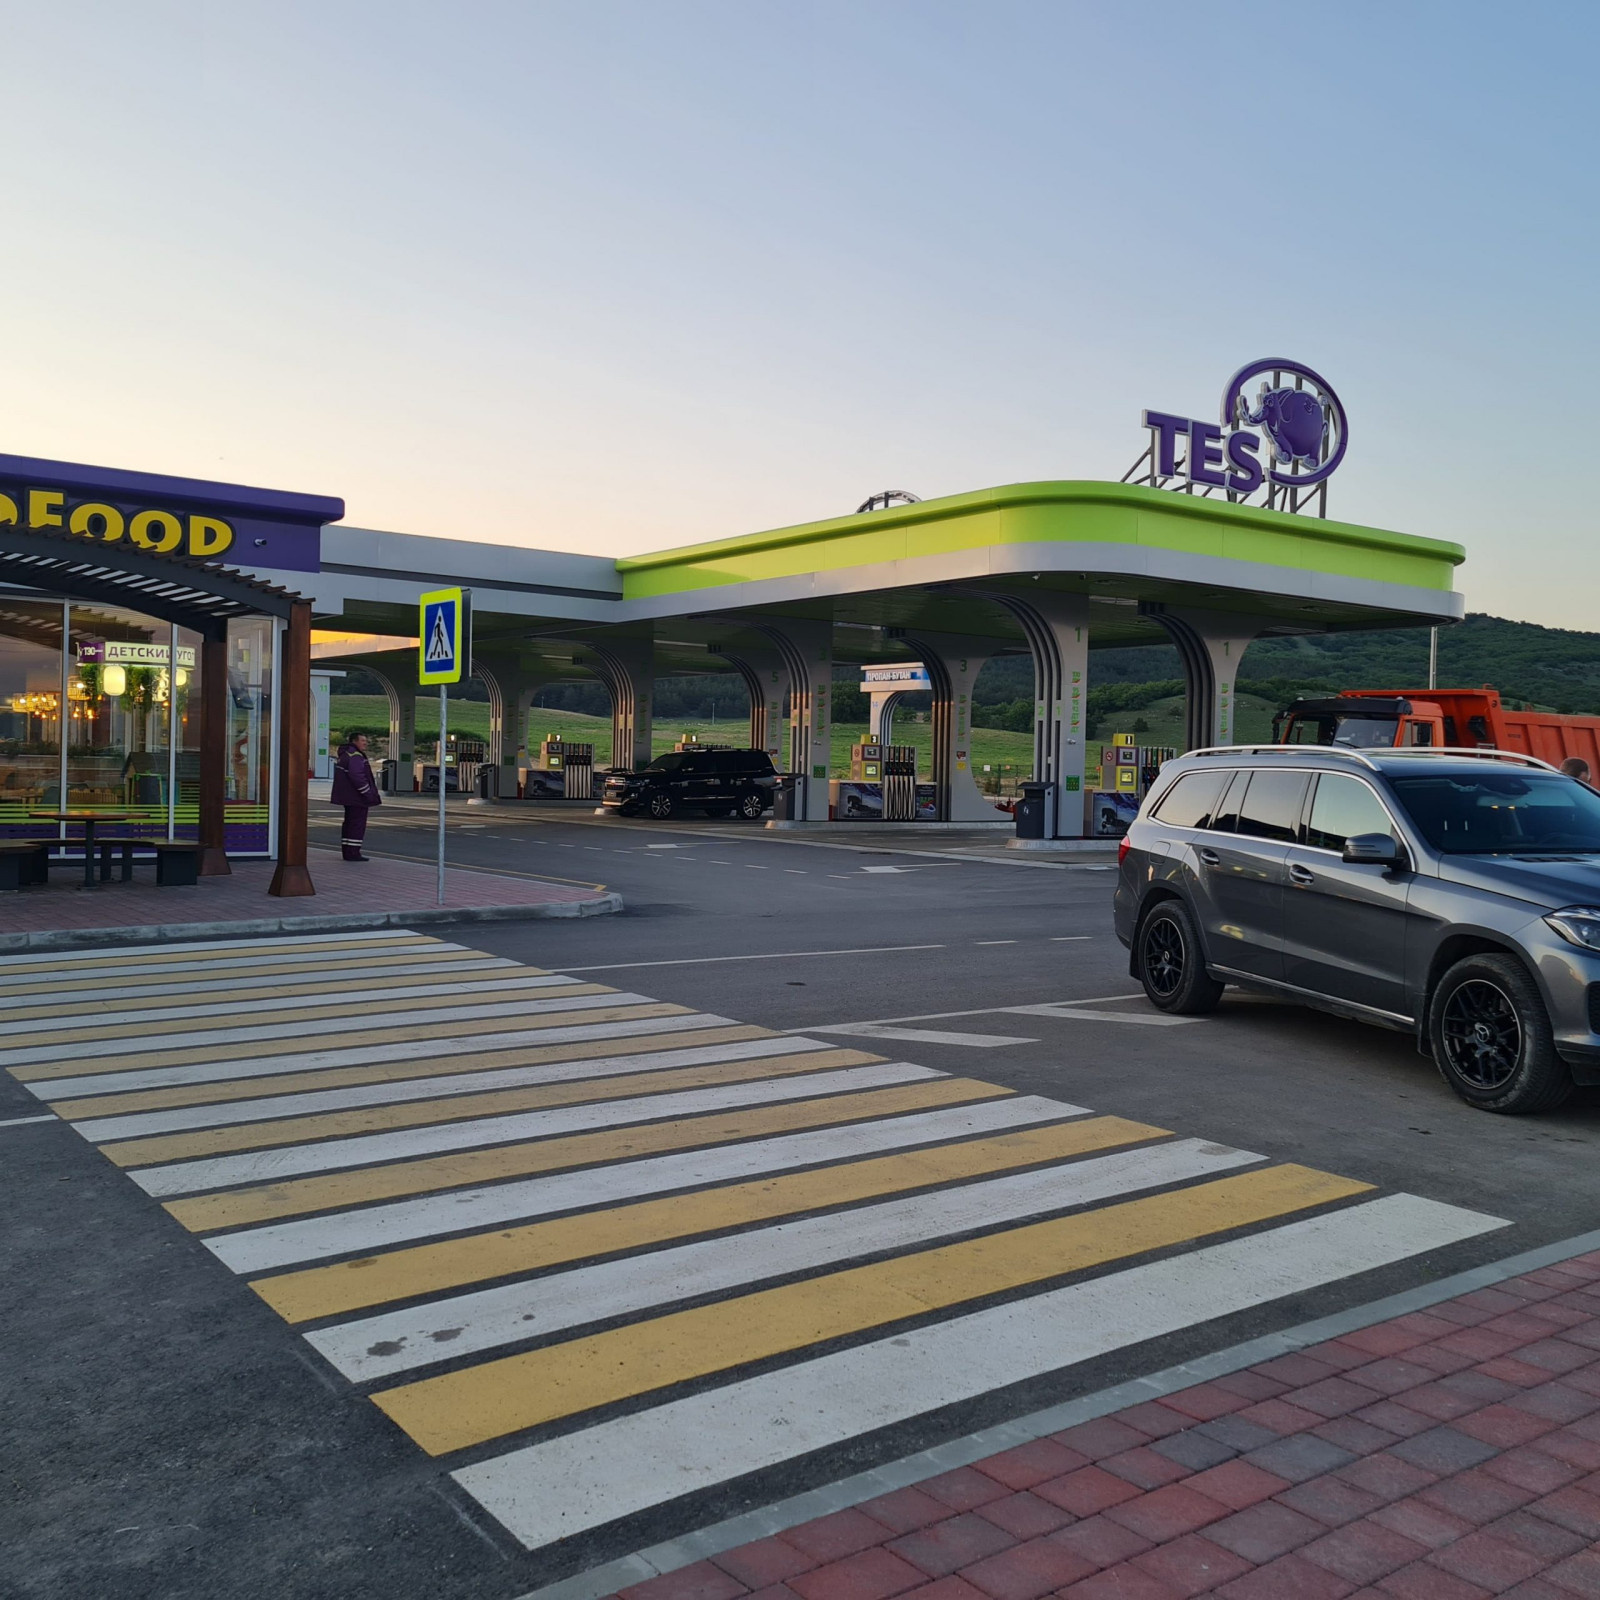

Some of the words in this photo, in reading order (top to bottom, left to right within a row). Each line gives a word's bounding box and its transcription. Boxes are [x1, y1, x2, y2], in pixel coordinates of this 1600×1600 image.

[1142, 408, 1263, 494] TES
[1074, 627, 1082, 642] 1
[1223, 641, 1230, 656] 1
[177, 650, 194, 661] УГО
[959, 659, 968, 672] 3
[771, 671, 779, 683] 5
[867, 671, 910, 681] ПРОПАН-БУТАН
[1127, 735, 1131, 744] 1
